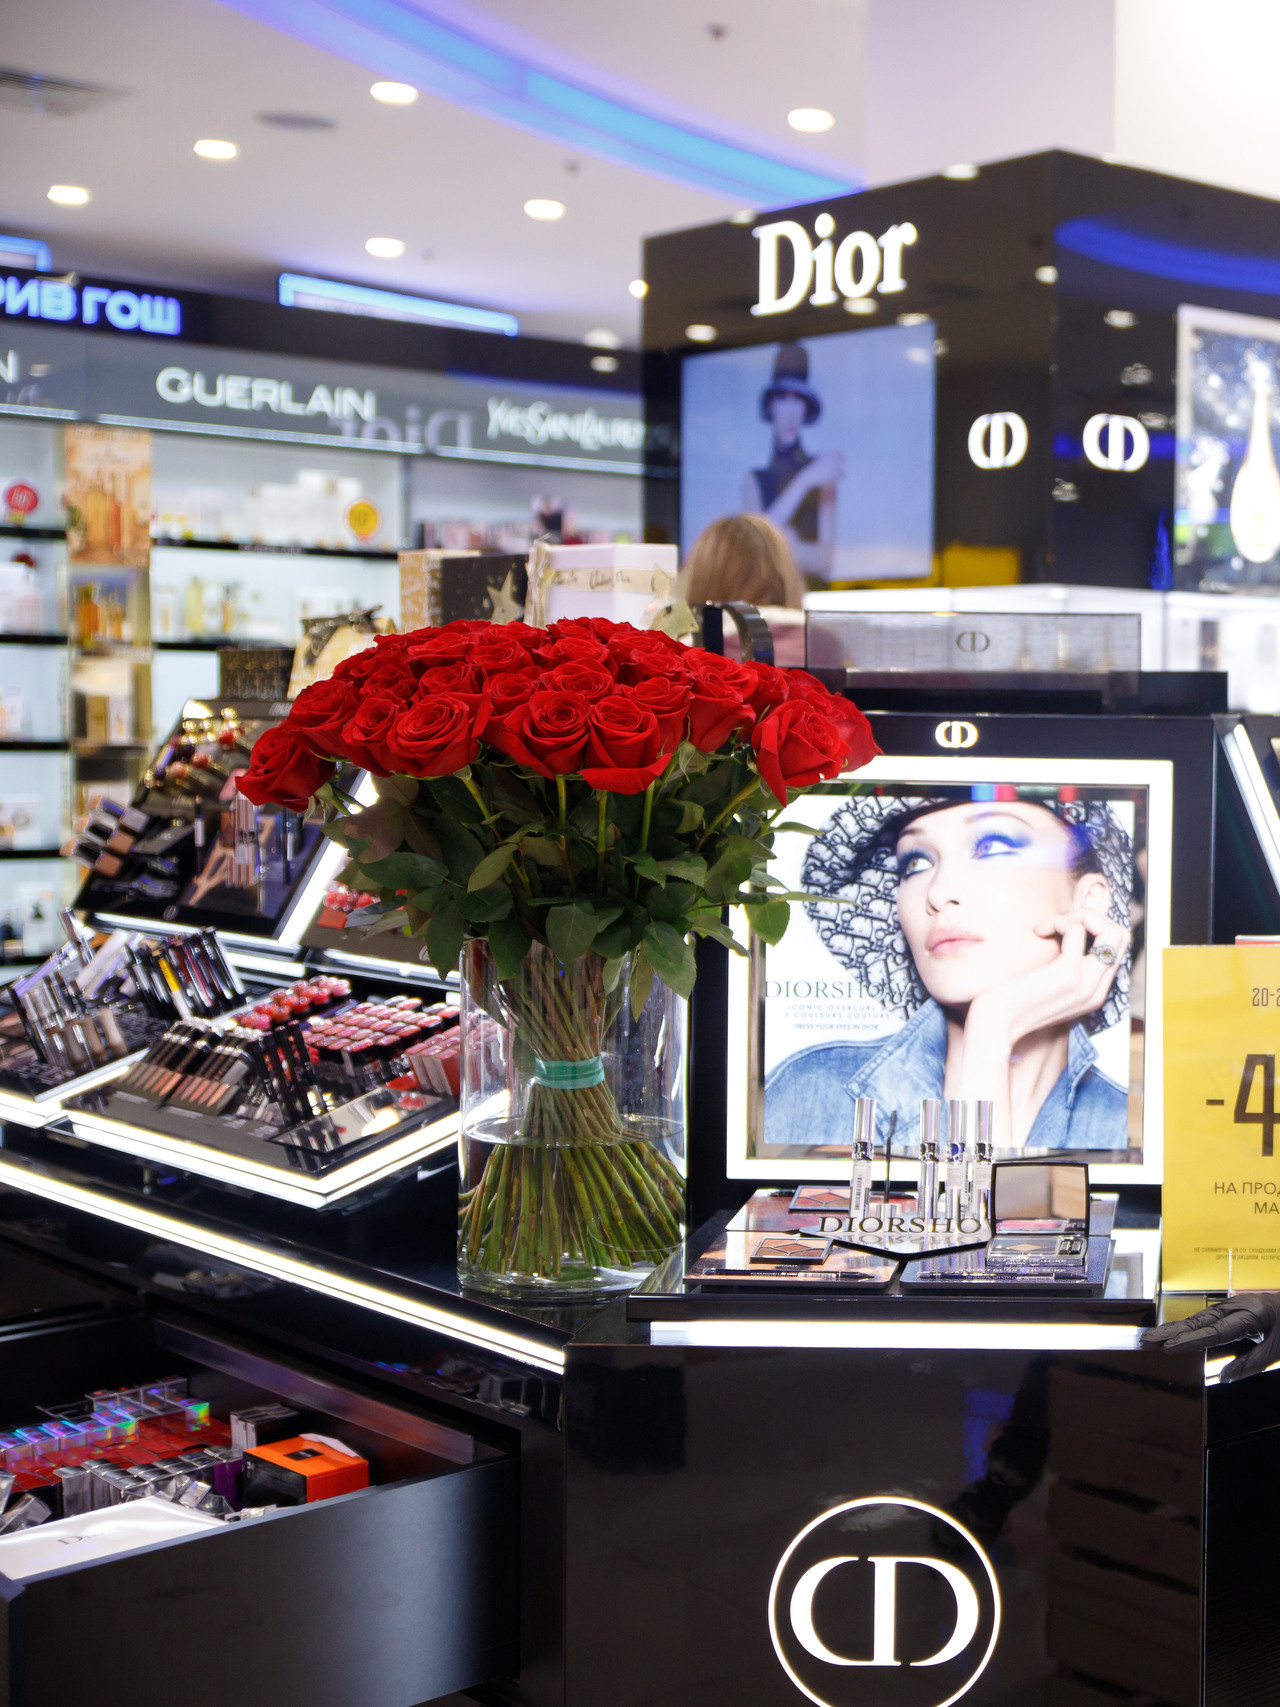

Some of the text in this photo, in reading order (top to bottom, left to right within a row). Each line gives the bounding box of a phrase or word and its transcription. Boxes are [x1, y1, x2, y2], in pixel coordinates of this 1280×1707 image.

[750, 212, 919, 316] Dior
[0, 276, 182, 336] ИВ ГОШ
[156, 366, 376, 422] GUERLAIN
[765, 980, 913, 1000] DIORSHOW
[847, 1012, 890, 1020] COUTURE
[862, 1023, 880, 1031] DIOR
[1214, 1181, 1239, 1196] НА
[818, 1216, 991, 1235] DIORSHO
